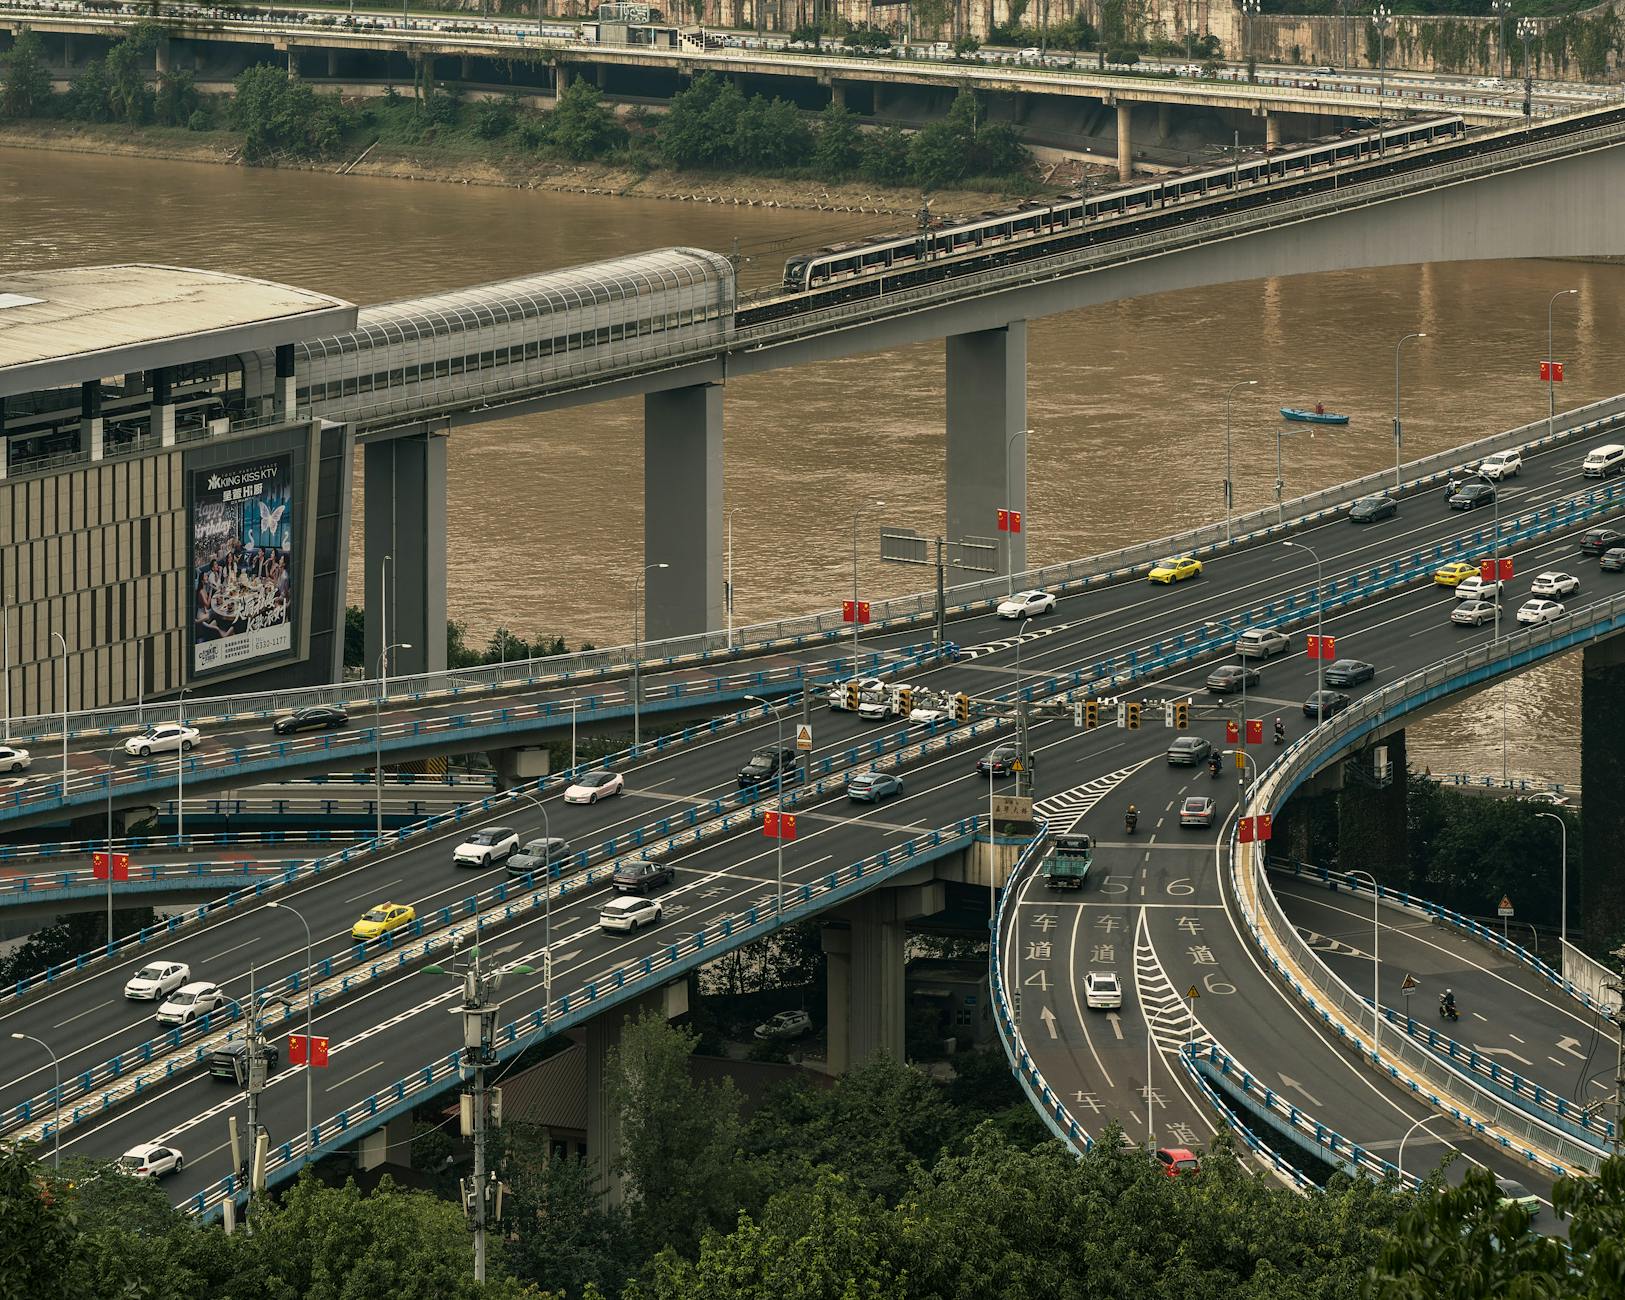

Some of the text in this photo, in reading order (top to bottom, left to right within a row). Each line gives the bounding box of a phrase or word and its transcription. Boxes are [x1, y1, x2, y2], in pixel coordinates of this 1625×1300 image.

[220, 475, 241, 488] KING
[241, 471, 261, 483] KISS
[260, 467, 278, 480] KTV
[1099, 875, 1134, 895] 5
[1166, 877, 1195, 896] 6
